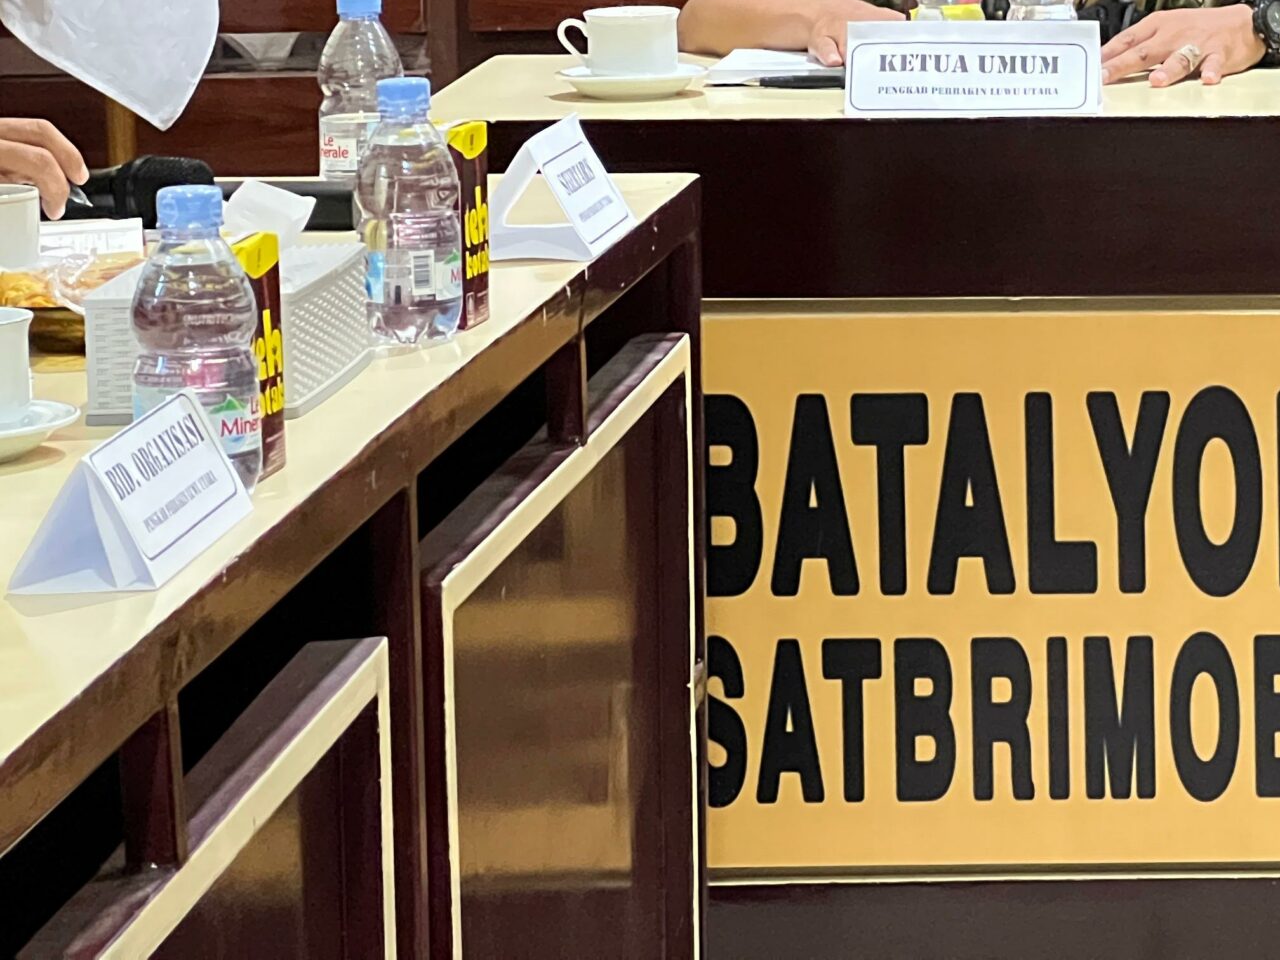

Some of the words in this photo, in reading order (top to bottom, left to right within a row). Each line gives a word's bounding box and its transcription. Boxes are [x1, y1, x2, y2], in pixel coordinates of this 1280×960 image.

[879, 54, 968, 73] KETUA
[978, 55, 1059, 74] UMUM
[878, 86, 928, 94] PENGKAB
[1023, 87, 1059, 96] UTARA
[251, 308, 283, 380] eh
